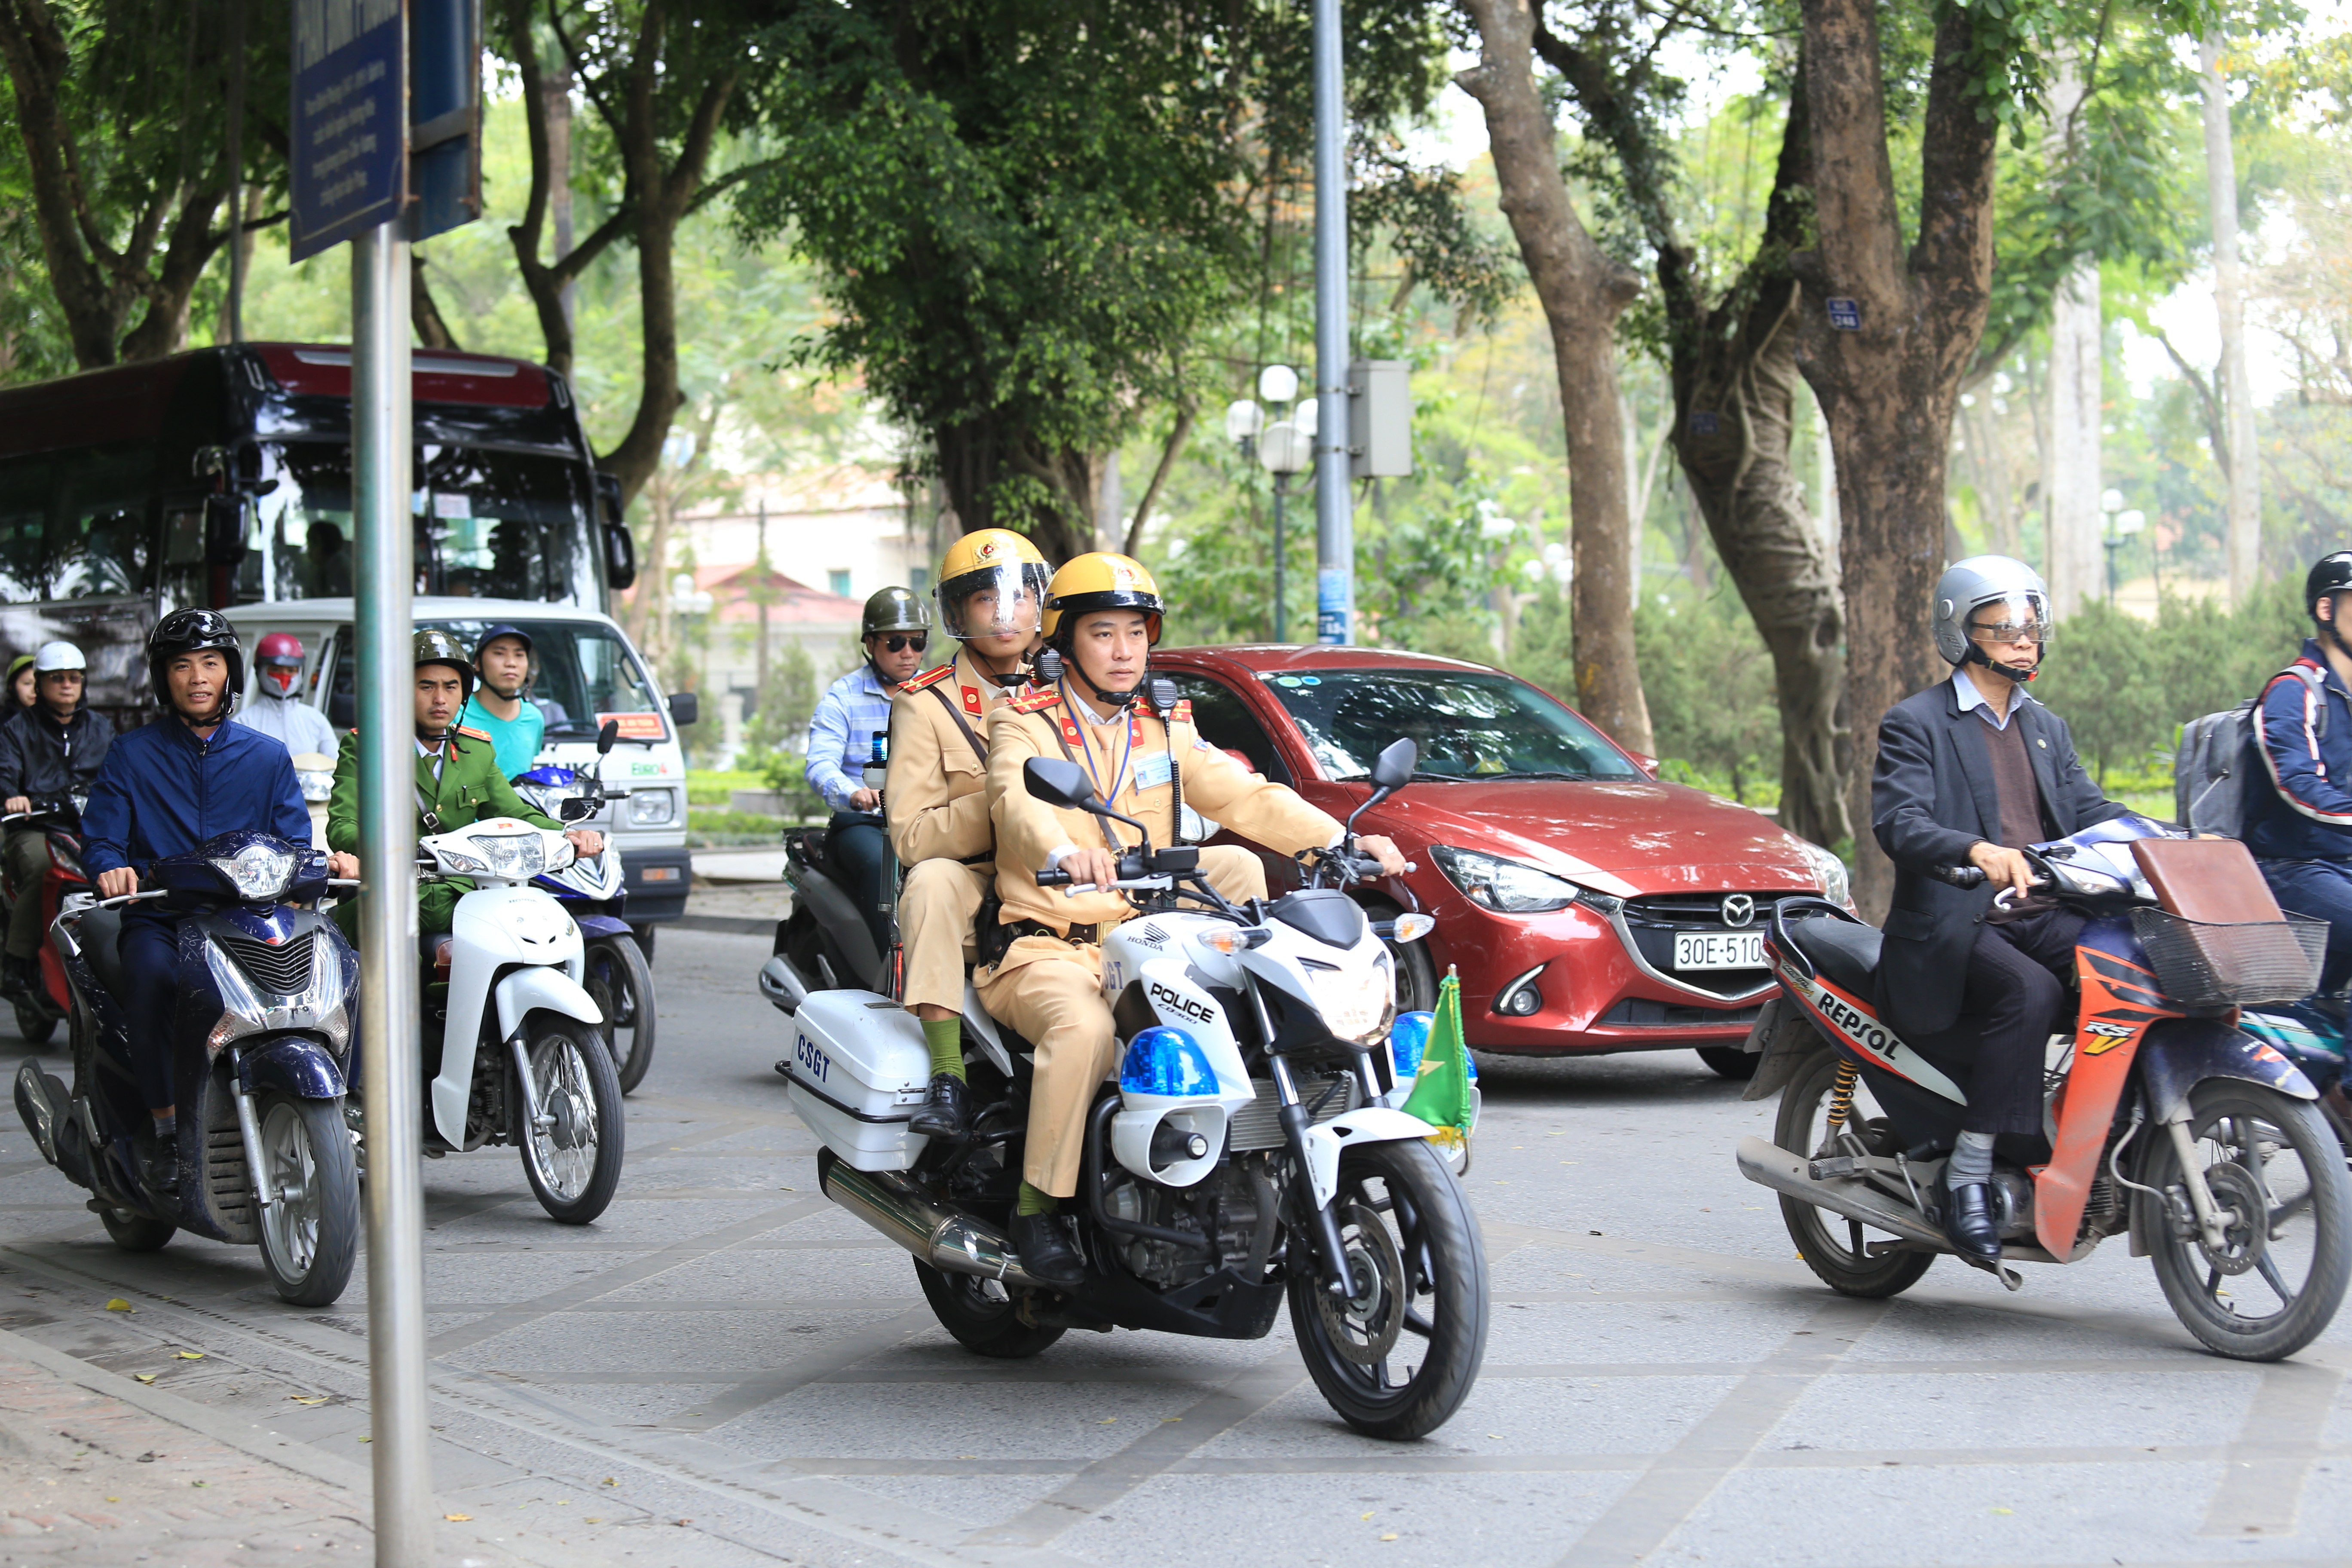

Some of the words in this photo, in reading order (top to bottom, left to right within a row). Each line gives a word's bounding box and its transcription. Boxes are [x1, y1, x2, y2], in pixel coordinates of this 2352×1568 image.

[1127, 936, 1163, 951] HONDA
[1680, 937, 1764, 964] 30E-510
[1150, 983, 1215, 1023] POLICE
[1818, 992, 1900, 1060] REPSOL
[798, 1034, 830, 1083] CSGT
